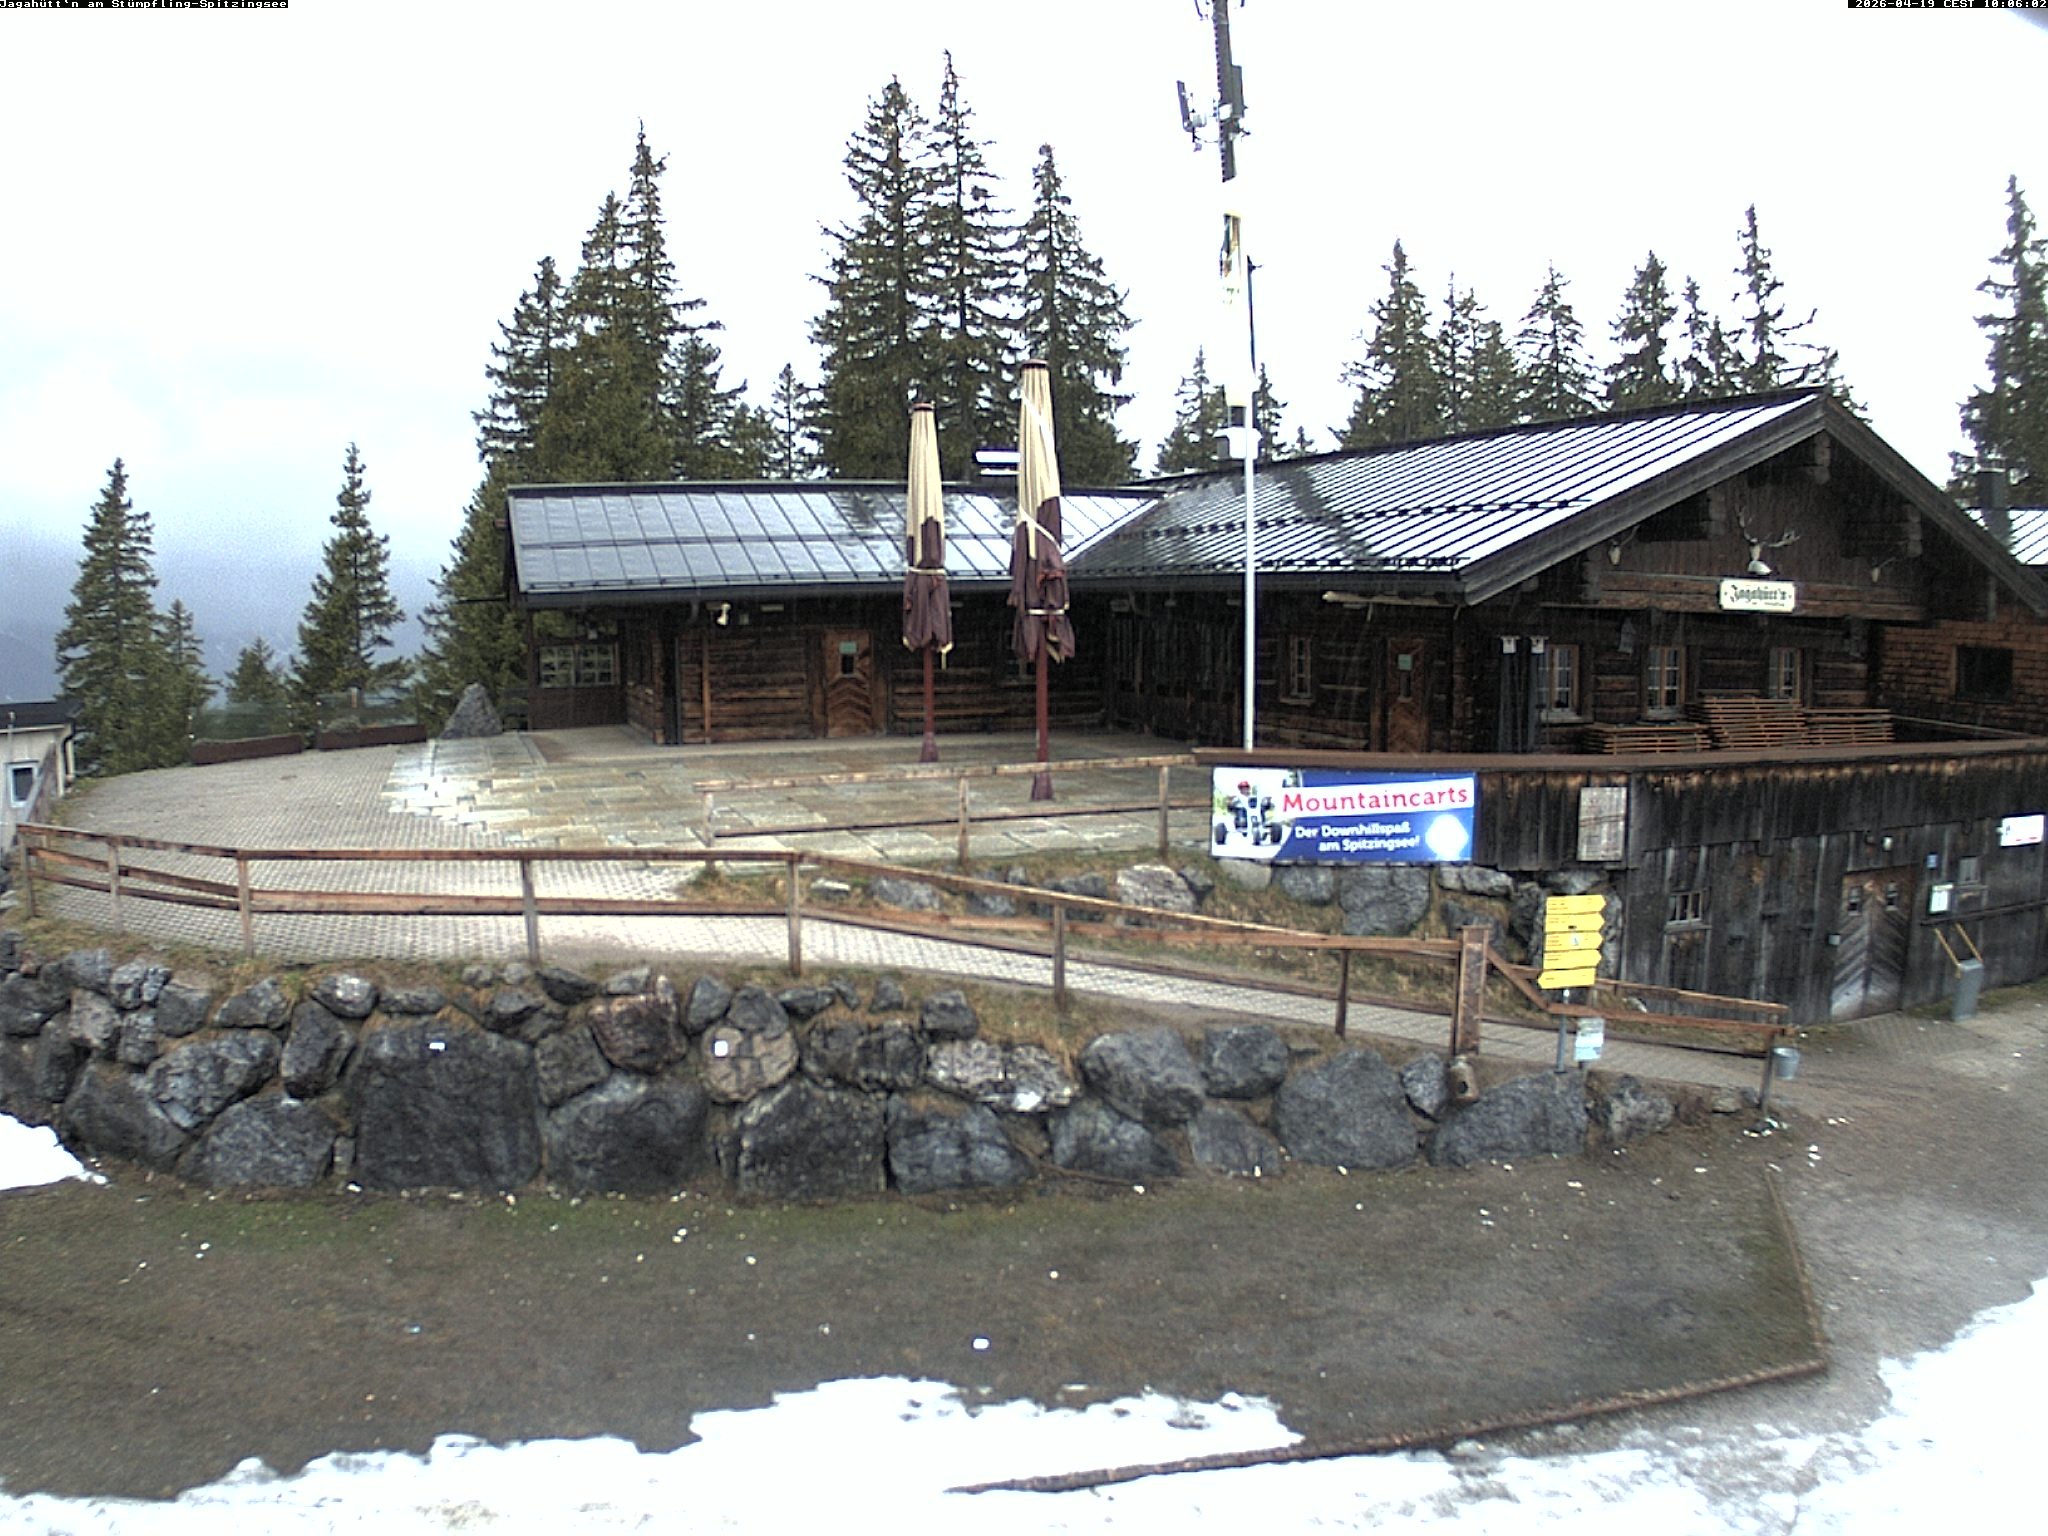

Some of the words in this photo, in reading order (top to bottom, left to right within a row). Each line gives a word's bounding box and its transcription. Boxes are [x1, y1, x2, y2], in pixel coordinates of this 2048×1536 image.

[1283, 786, 1468, 812] Mountaincarts
[1295, 826, 1318, 838] Der
[1321, 821, 1411, 837] Downhillspaß
[1318, 841, 1341, 852] am
